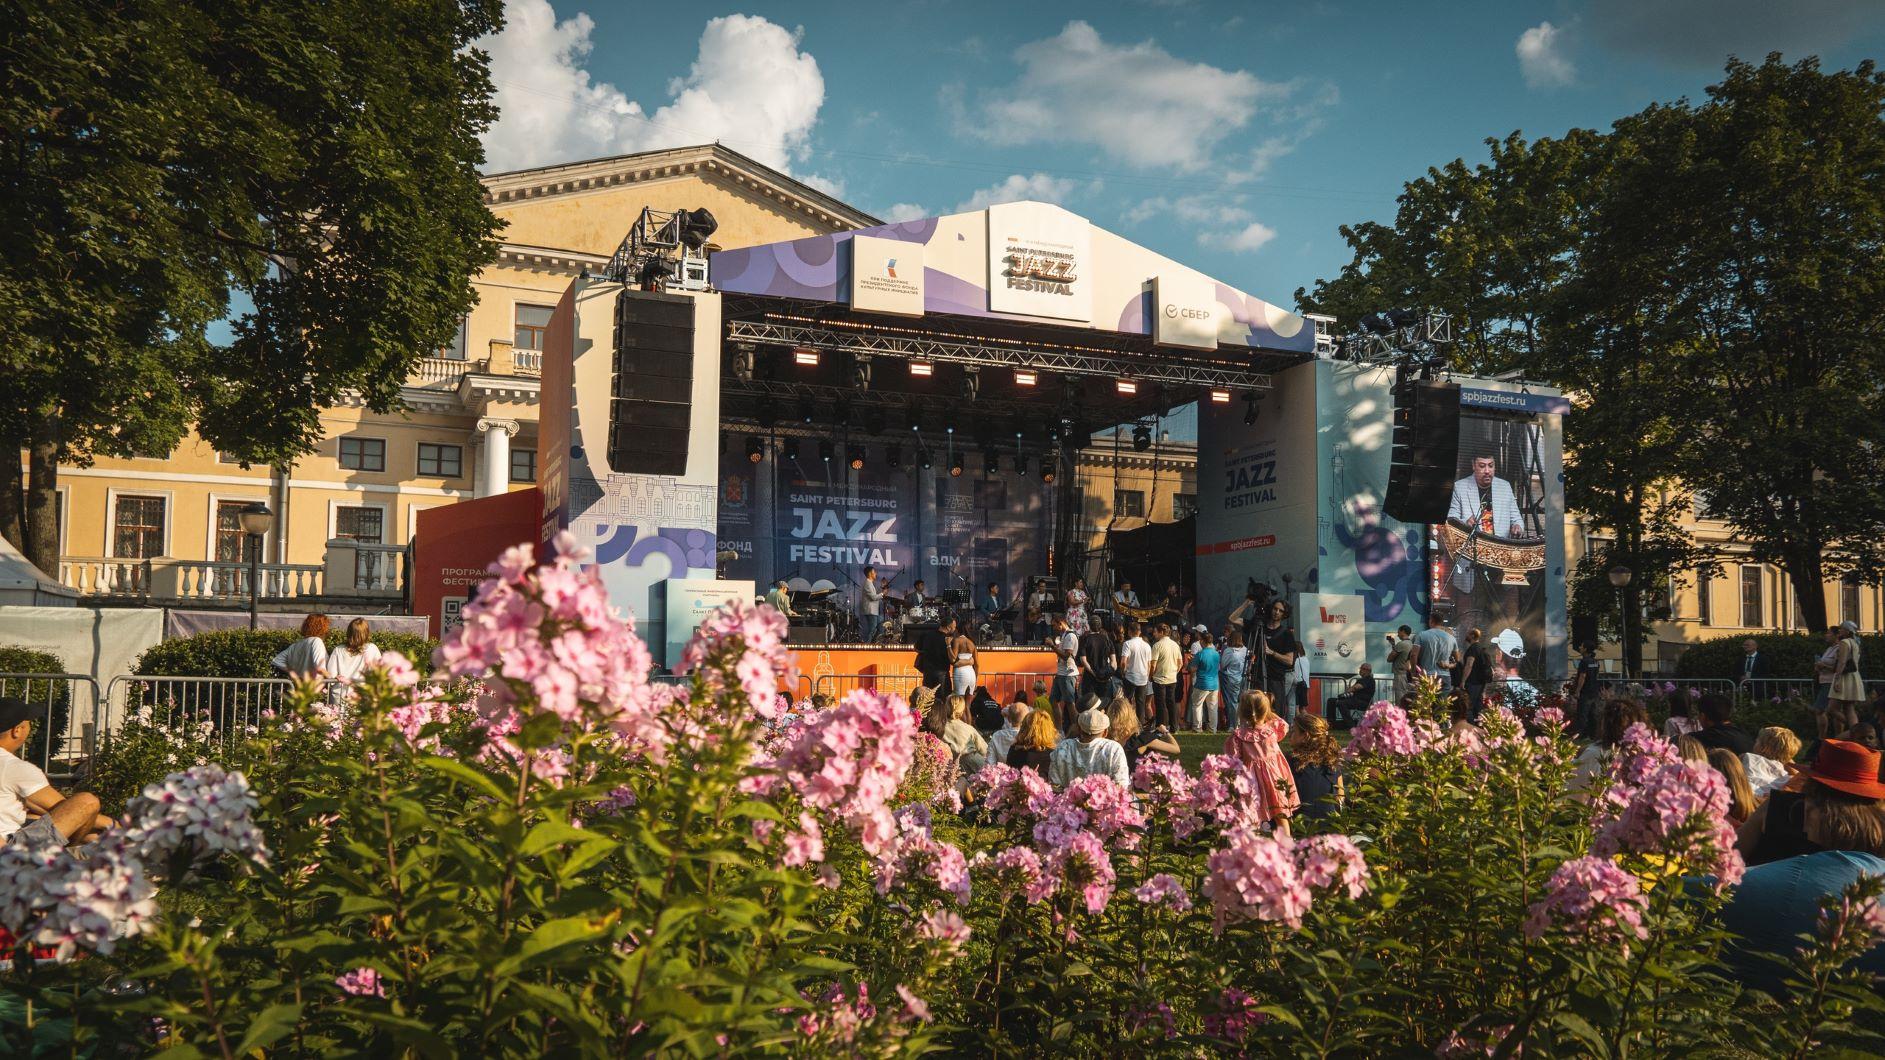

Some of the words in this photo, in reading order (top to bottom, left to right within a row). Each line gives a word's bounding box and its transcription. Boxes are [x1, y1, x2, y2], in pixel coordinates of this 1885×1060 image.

[1006, 246, 1028, 254] SAINT
[1004, 253, 1077, 283] JAZZ
[1006, 277, 1074, 296] FESTIVAL
[1181, 308, 1210, 320] СБЕР
[1462, 391, 1526, 406] spbjazzfest.ru
[1225, 460, 1277, 492] JAZZ
[790, 494, 823, 504] SAINT
[826, 496, 897, 508] PETERSBURG
[1225, 488, 1277, 509] FESTIVAL
[790, 508, 898, 543] JAZZ
[717, 541, 752, 553] ФОНД
[1230, 537, 1271, 551] spbjazzfest.ru
[790, 545, 899, 566] FESTIVAL
[442, 568, 505, 577] ПРОГРАММ
[443, 578, 485, 586] ФЕСТИВ
